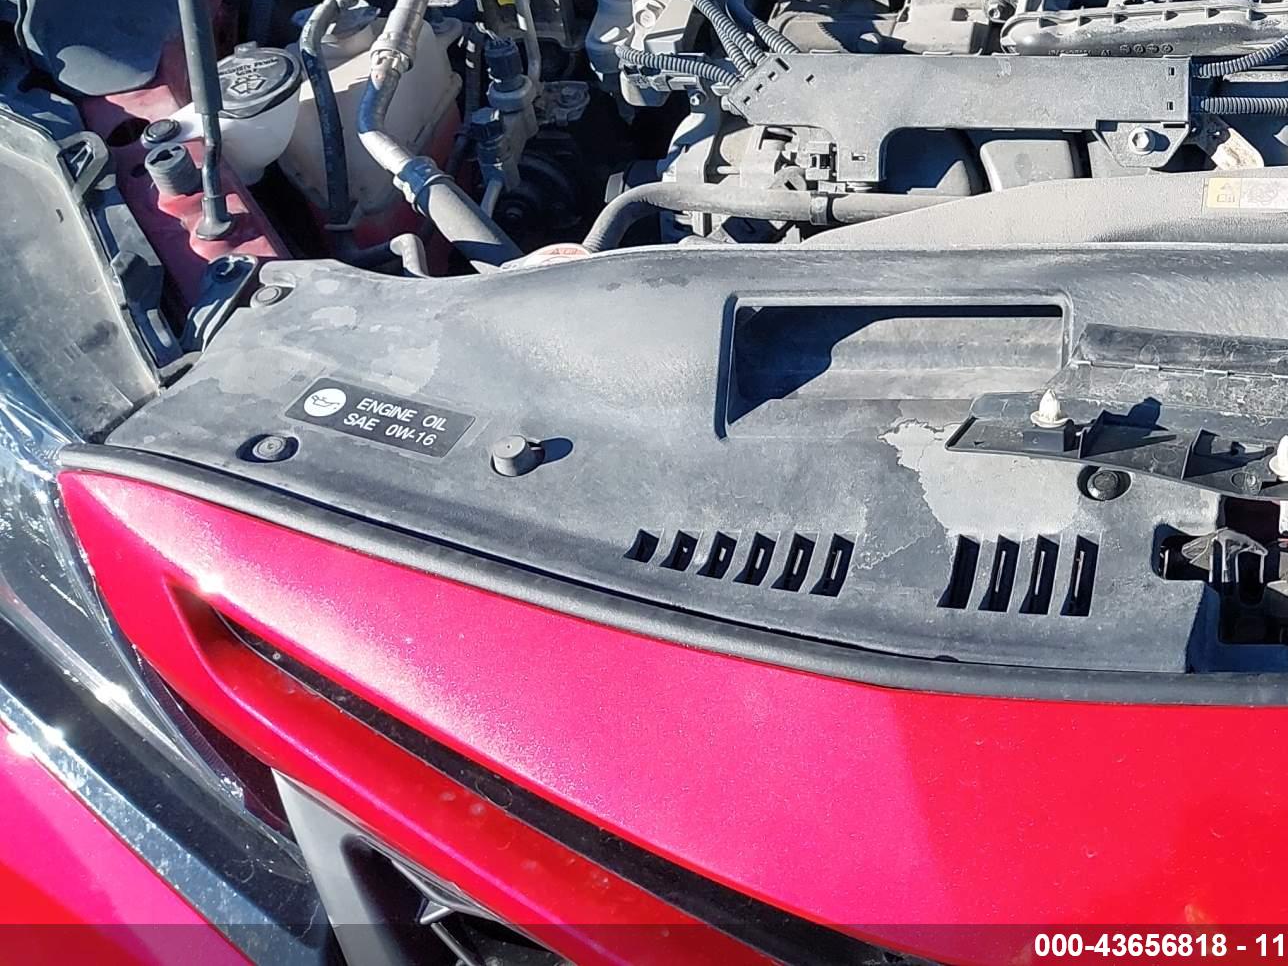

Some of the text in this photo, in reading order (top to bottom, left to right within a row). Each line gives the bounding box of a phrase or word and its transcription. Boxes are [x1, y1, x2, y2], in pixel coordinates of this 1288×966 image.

[343, 412, 437, 447] SAE 0W-16
[356, 397, 448, 432] ENGINE OIL
